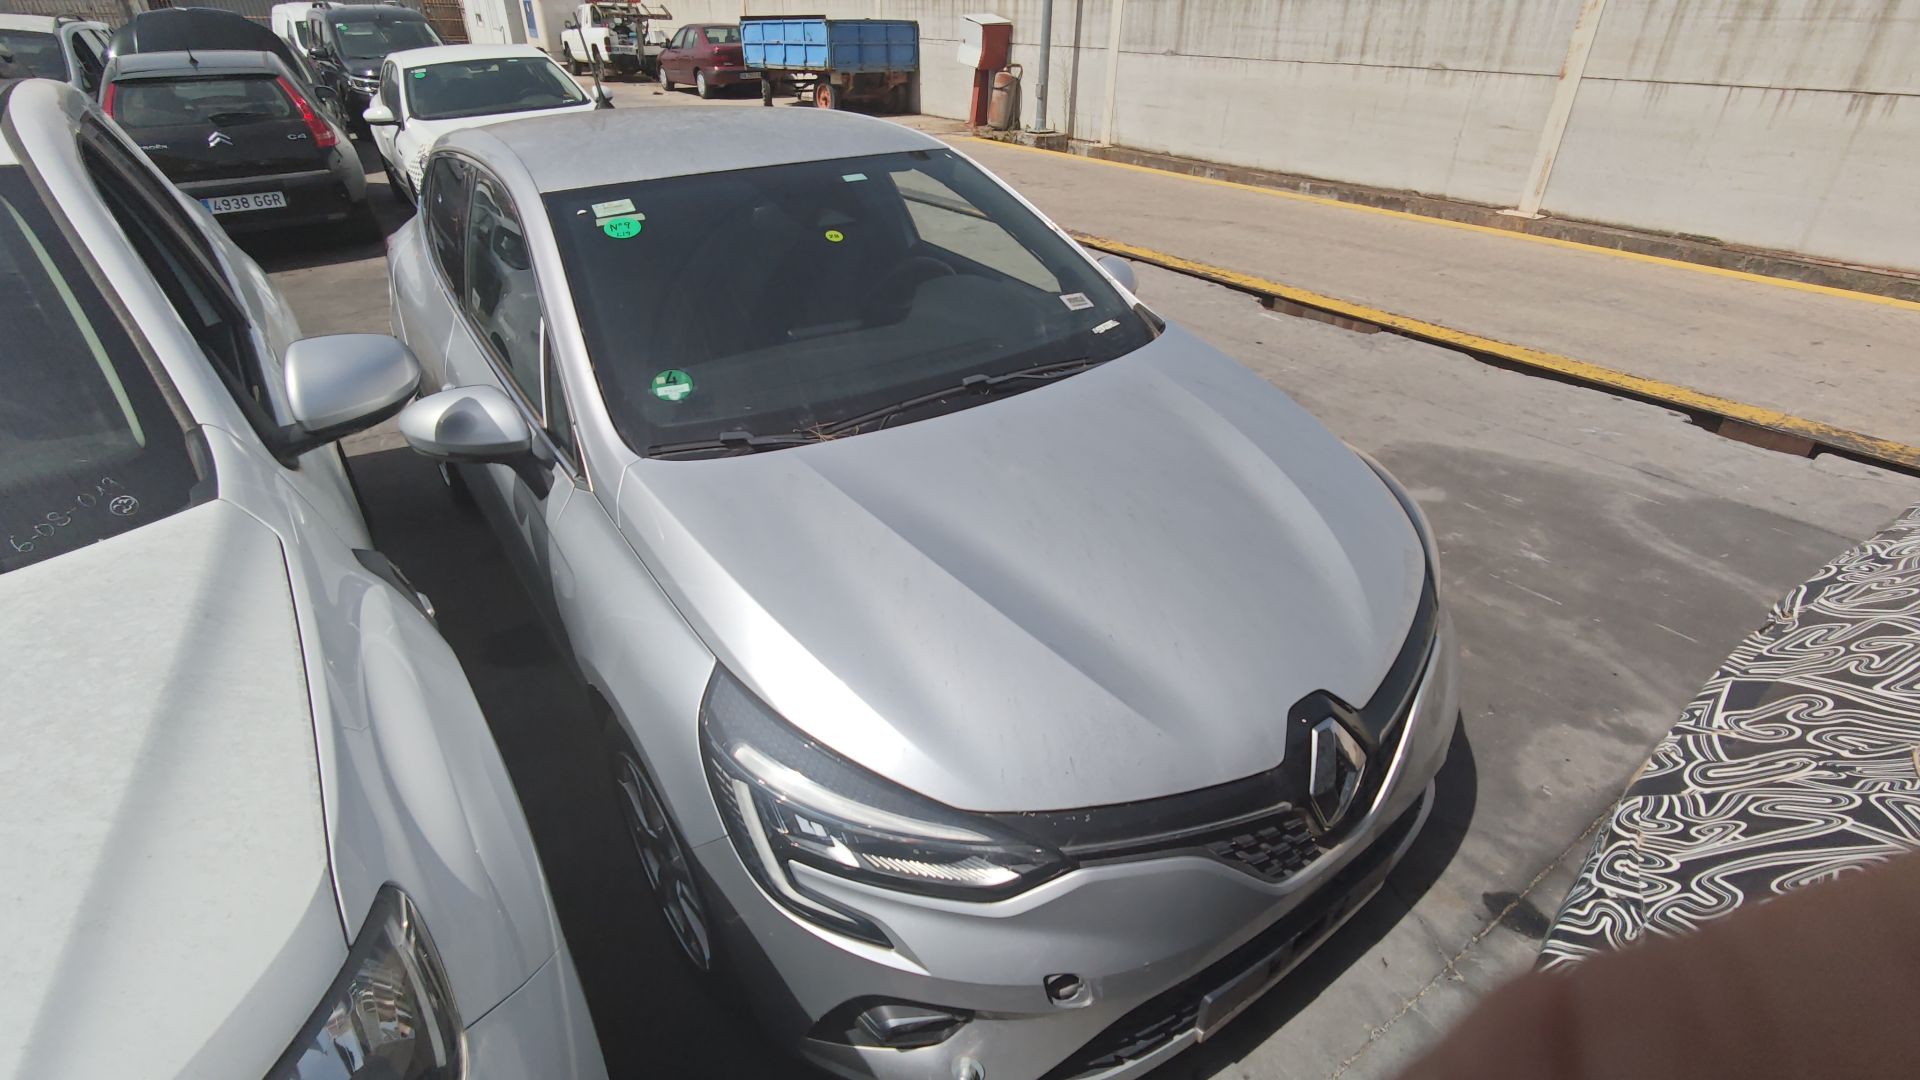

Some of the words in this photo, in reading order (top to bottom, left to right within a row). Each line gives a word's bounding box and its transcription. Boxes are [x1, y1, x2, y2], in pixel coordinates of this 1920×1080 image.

[287, 132, 307, 141] C4
[213, 197, 250, 211] 4938
[253, 193, 282, 207] GGR
[665, 370, 677, 385] 4
[112, 497, 136, 514] 23
